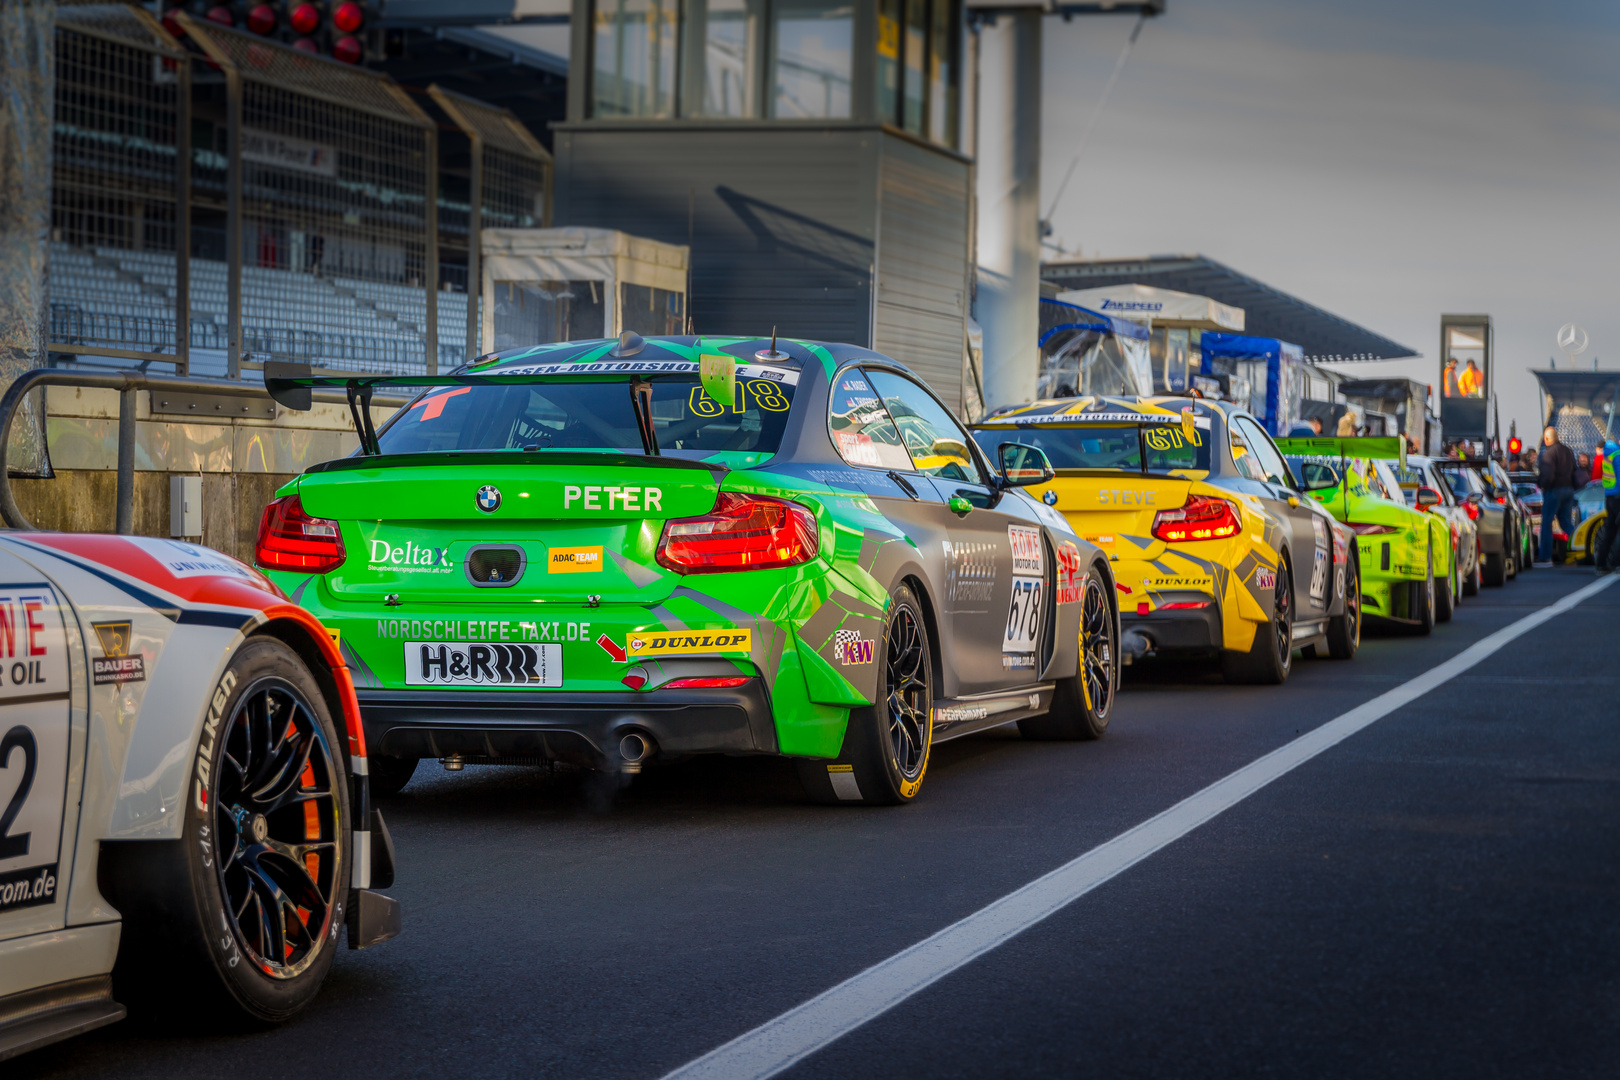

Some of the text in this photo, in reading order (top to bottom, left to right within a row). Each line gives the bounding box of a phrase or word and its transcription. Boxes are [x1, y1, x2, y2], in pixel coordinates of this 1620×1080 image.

[564, 485, 661, 511] PETER
[1099, 489, 1155, 505] STEVE
[1011, 530, 1039, 558] ROWE
[1015, 558, 1040, 570] MOTOR OIL
[1260, 573, 1276, 589] KW
[1008, 580, 1041, 641] 678
[377, 620, 591, 641] NORDSCHLEIFE-TAXI.DE
[649, 635, 747, 649] DUNLOP
[842, 639, 874, 665] KW
[11, 661, 46, 685] OIL
[95, 659, 142, 673] BAUER
[95, 672, 144, 682] RENNKASKO.DE
[195, 669, 237, 813] FALKEN
[0, 725, 38, 860] 2
